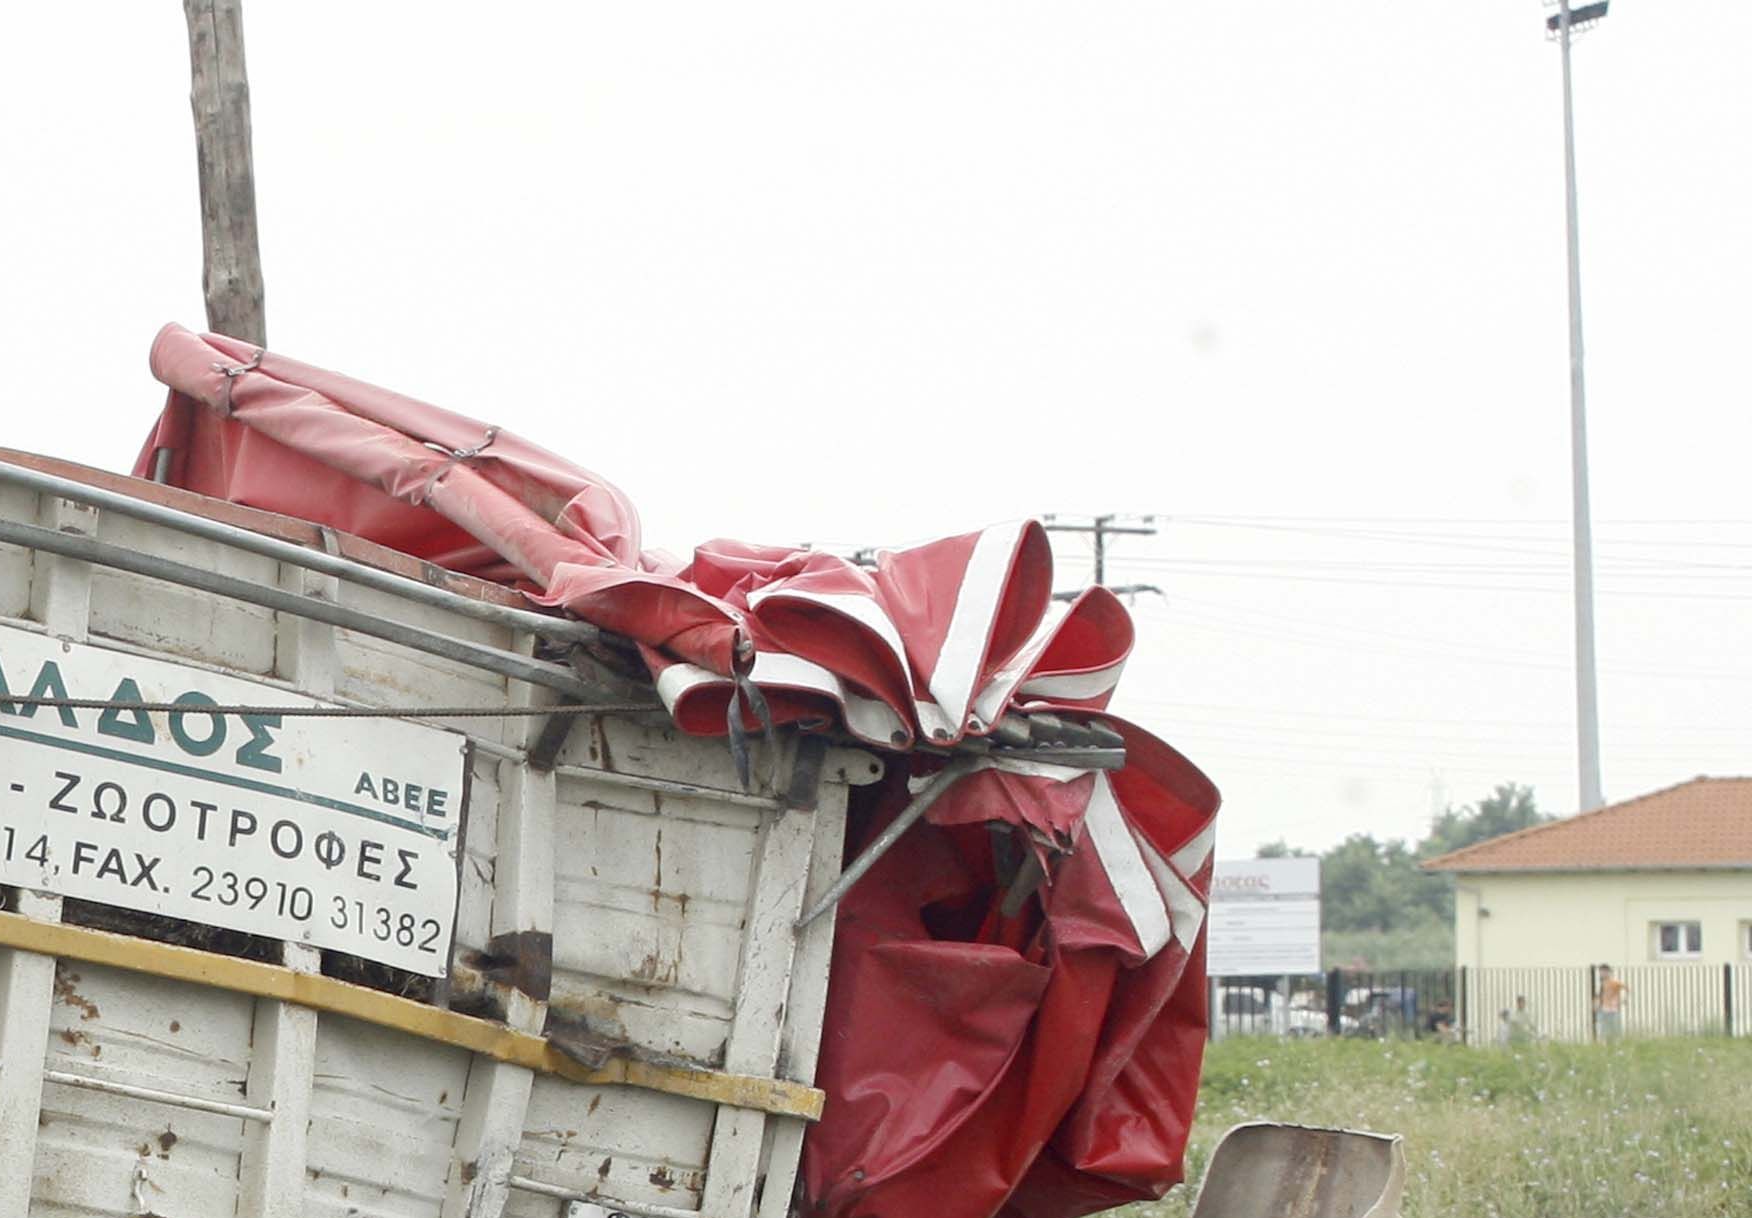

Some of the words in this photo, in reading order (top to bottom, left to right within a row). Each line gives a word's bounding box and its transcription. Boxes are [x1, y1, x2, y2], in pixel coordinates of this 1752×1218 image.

[49, 772, 418, 890] ΖΩΟΤΡΟΦΕΣ
[354, 772, 448, 817] ΑΒΕΕ
[191, 866, 314, 921] 23910
[330, 894, 441, 954] 31382
